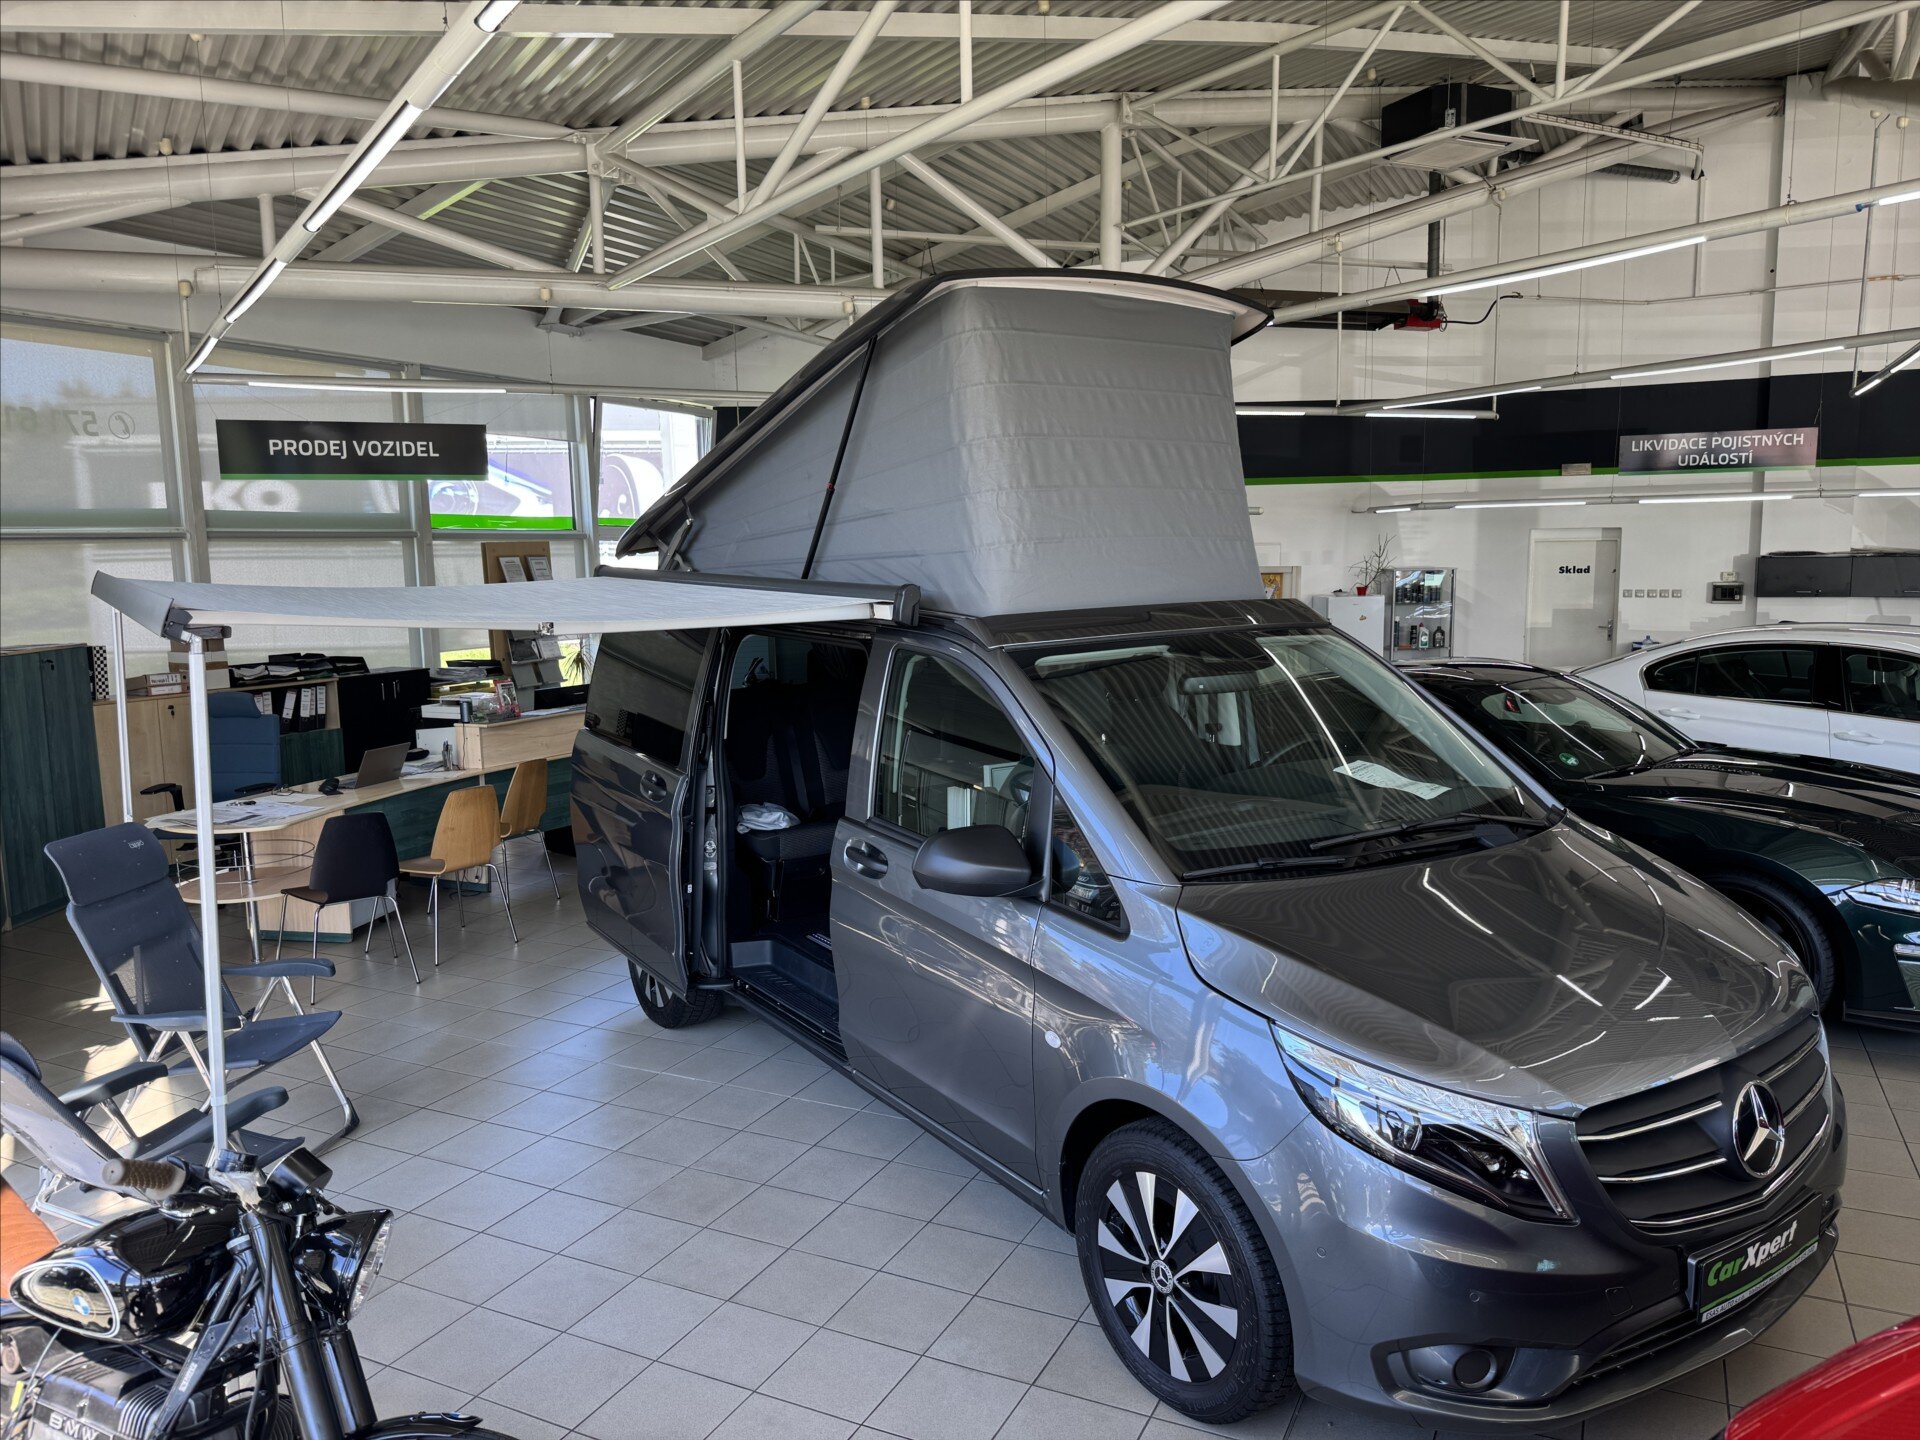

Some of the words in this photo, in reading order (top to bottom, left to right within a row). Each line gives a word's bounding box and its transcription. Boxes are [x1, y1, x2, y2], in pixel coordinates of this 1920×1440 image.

[268, 439, 348, 460] PRODEJ
[352, 440, 440, 458] VOZIDEL
[1631, 437, 1707, 452] LIKVIDACE
[1711, 432, 1804, 450] POJISTNÝCH
[1678, 450, 1754, 467] UDÁLOSTÍ
[1558, 565, 1591, 574] Sklad
[1707, 1219, 1798, 1287] CarXpert
[49, 1411, 100, 1440] BMW
